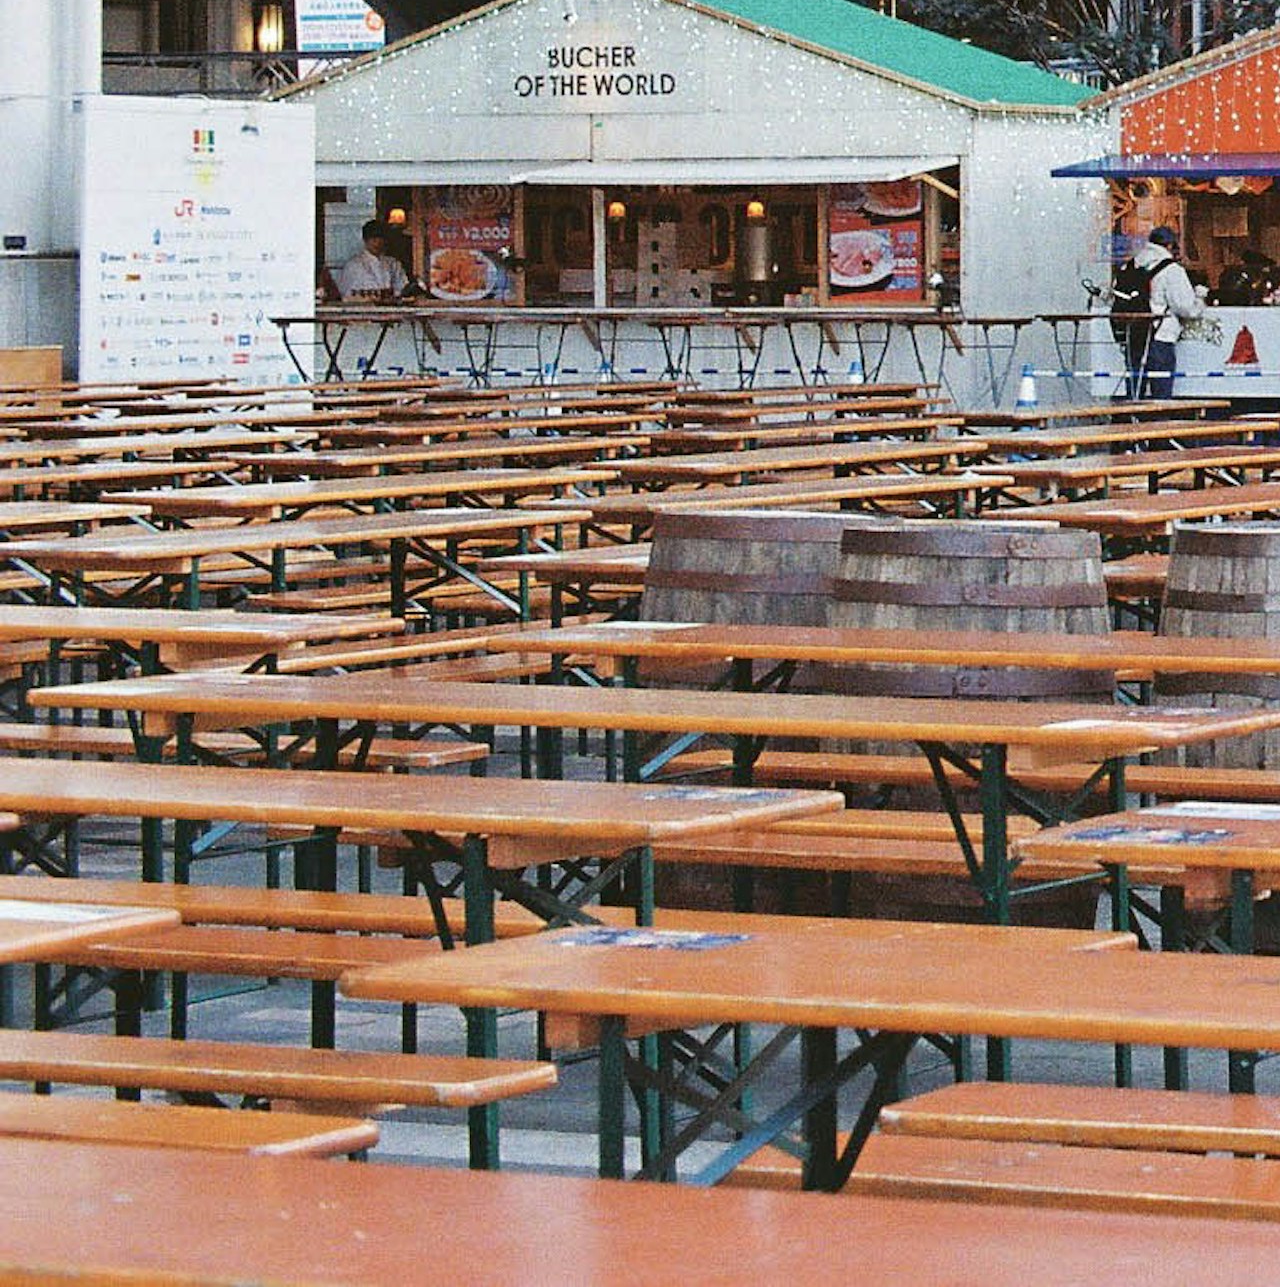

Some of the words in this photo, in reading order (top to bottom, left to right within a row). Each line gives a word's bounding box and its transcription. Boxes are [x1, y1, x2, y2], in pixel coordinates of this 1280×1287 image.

[548, 46, 636, 69] BUCHER
[515, 75, 544, 97] OF
[550, 74, 587, 96] THE
[593, 73, 675, 96] WORLD
